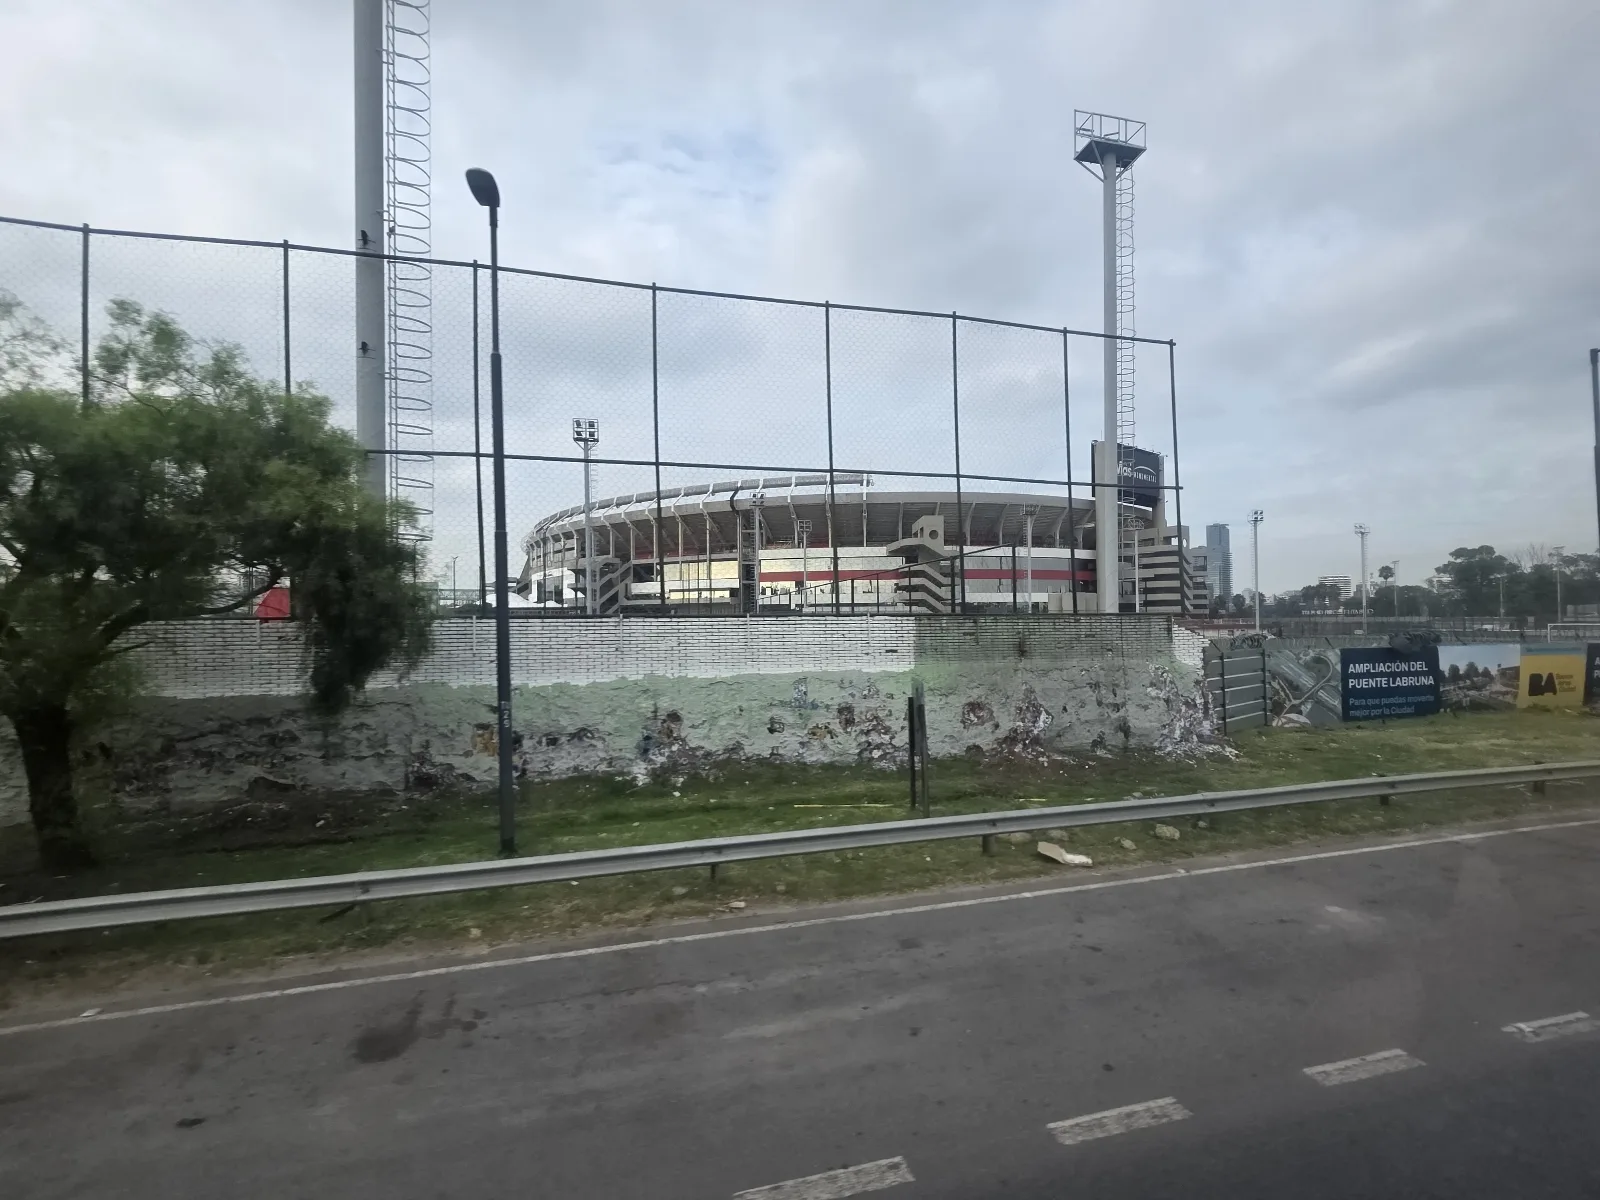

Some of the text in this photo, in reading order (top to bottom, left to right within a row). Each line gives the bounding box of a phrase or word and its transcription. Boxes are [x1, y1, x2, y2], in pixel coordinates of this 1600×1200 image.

[1348, 660, 1428, 673] AMPLIACIÓN DEL
[1348, 675, 1435, 689] PUENTE LABRUNA
[1528, 672, 1558, 697] BA
[1349, 697, 1366, 706] Para
[1367, 698, 1380, 706] que
[1381, 696, 1406, 705] puedas
[1349, 708, 1370, 718] mejor
[1370, 708, 1383, 716] por
[1391, 705, 1415, 714] Ciudad
